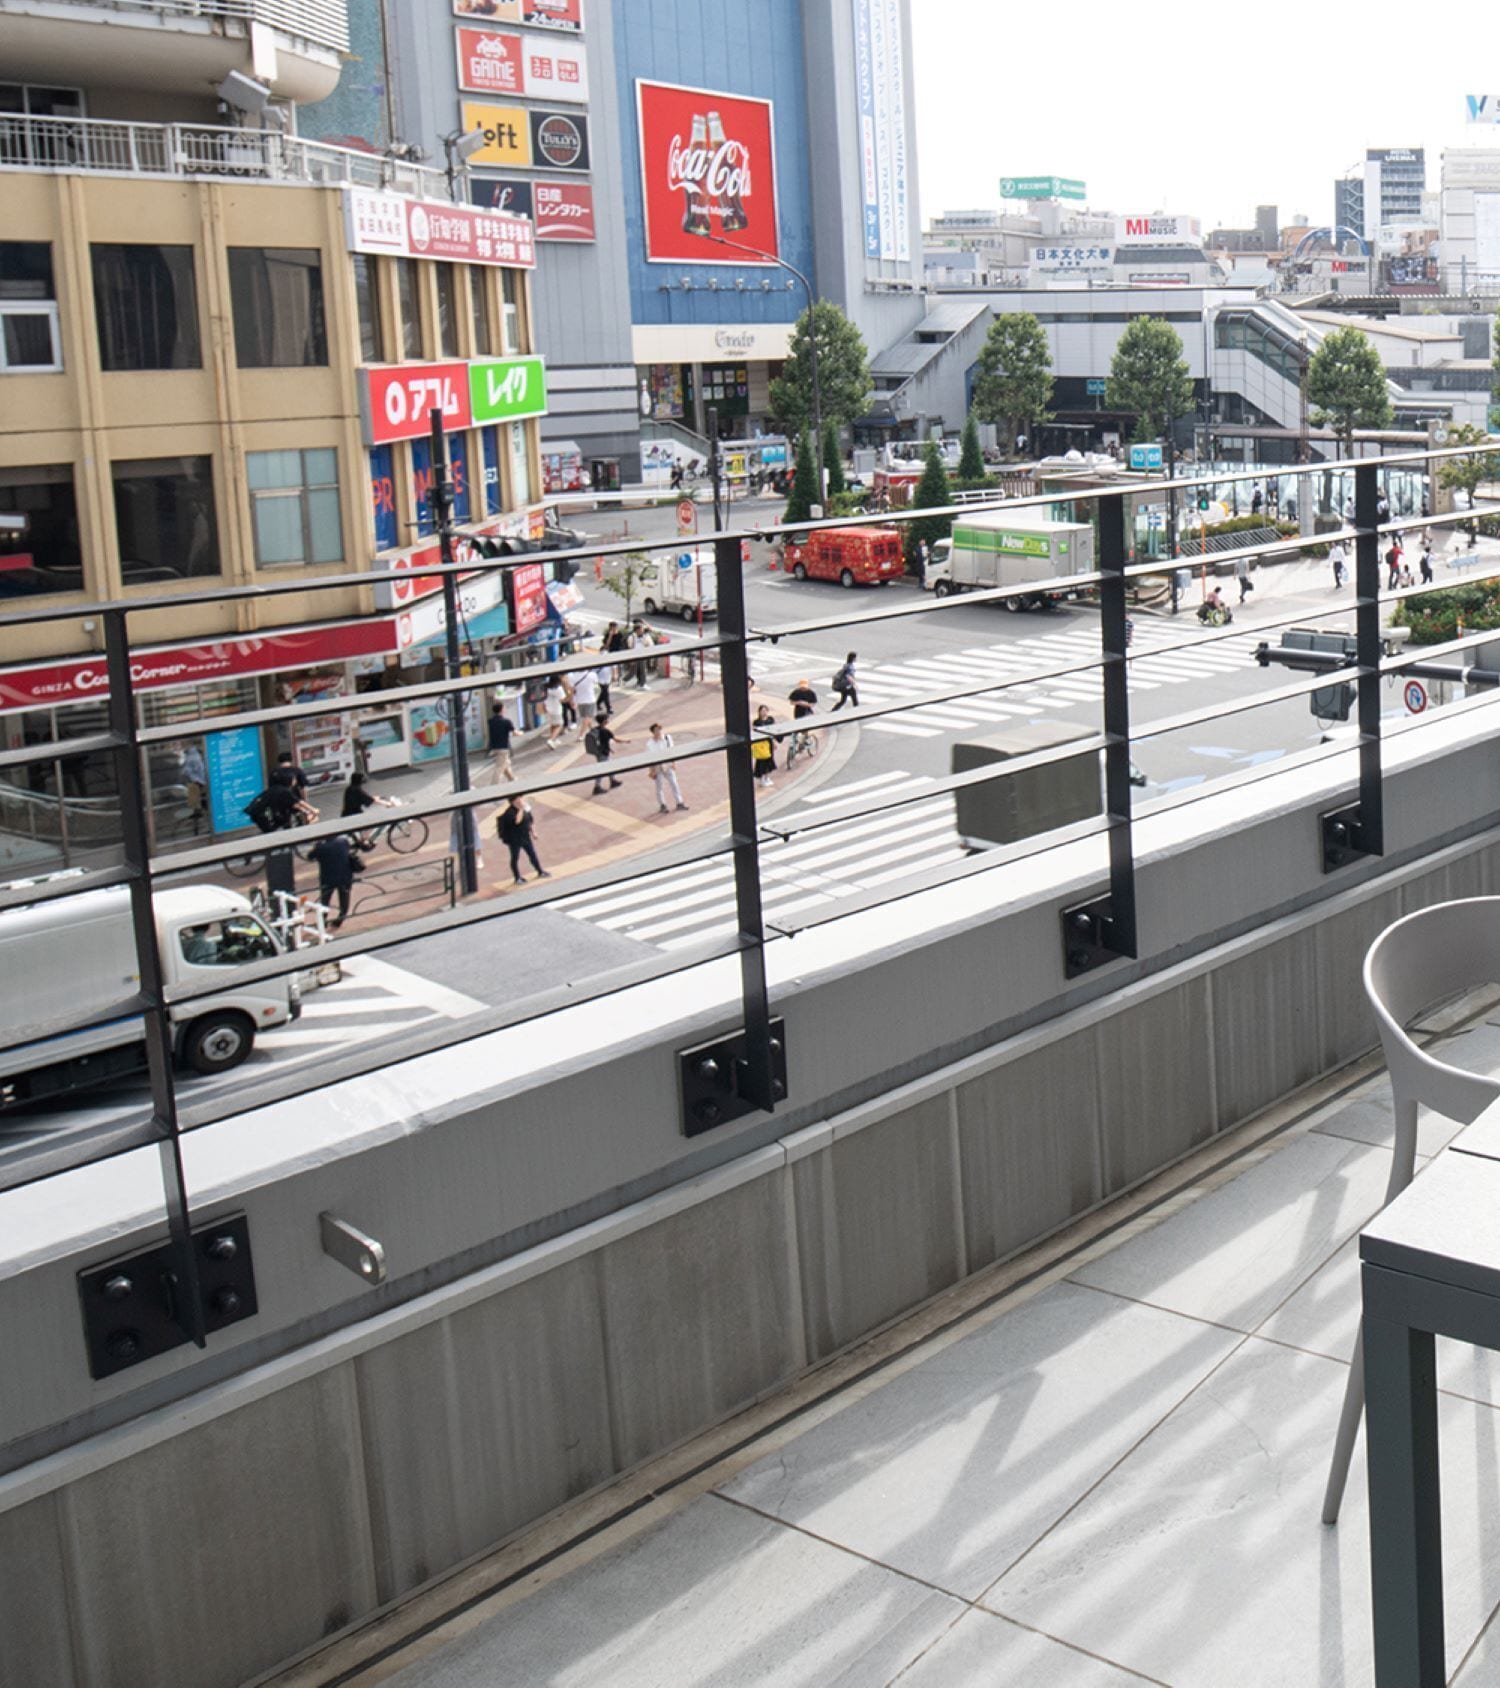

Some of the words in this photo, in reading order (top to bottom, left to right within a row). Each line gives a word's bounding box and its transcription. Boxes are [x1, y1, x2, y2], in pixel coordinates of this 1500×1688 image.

[470, 56, 516, 82] GAME
[668, 134, 752, 198] Coca-Cola
[538, 204, 591, 218] レンタカー
[1126, 218, 1150, 237] MI
[1150, 227, 1178, 236] MUSIC
[486, 366, 529, 407] レイク
[408, 377, 461, 423] アコム
[1002, 534, 1049, 553] NewDays
[31, 682, 73, 696] GINZA
[130, 663, 187, 683] Corner
